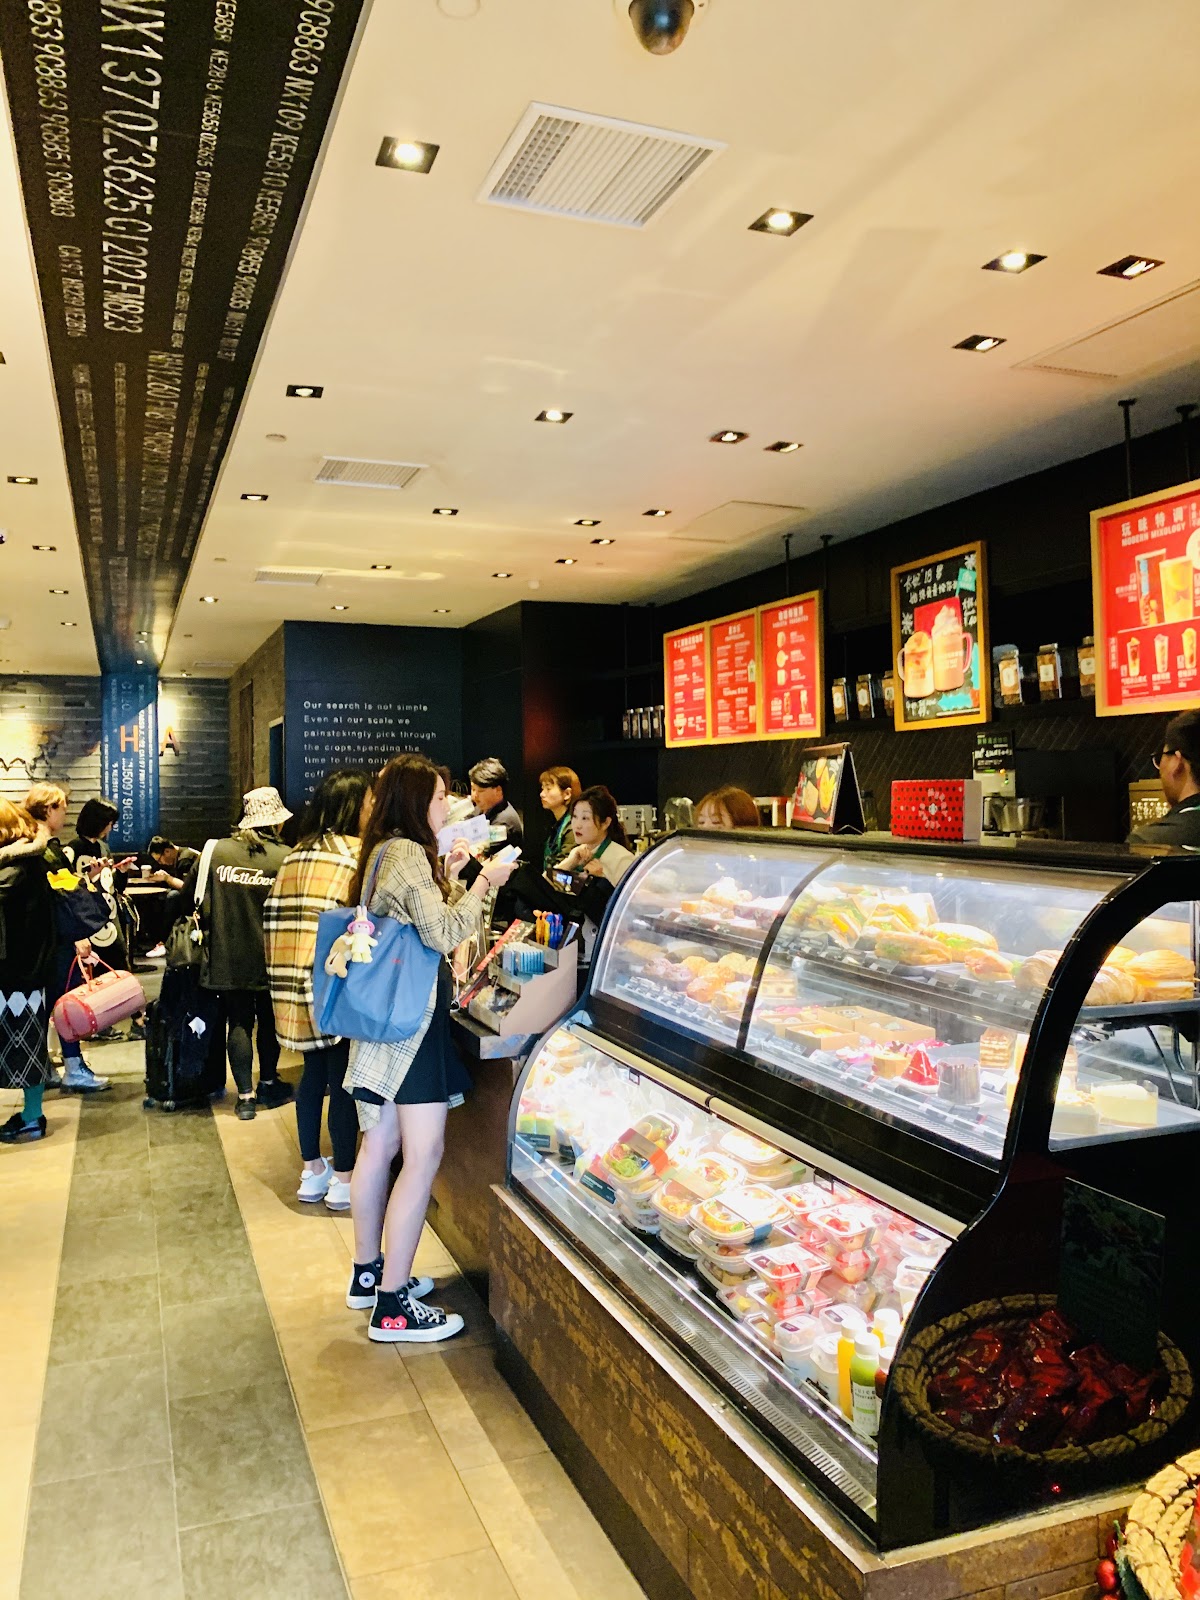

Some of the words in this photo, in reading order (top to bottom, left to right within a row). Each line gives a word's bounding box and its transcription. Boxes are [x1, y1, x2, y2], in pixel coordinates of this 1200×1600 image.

[28, 0, 64, 40] 853
[1121, 506, 1184, 537] 玩味特调
[1150, 522, 1186, 539] MIXOLOGY
[303, 701, 322, 710] Our
[326, 702, 360, 710] search
[364, 702, 373, 711] is
[377, 703, 393, 711] not
[396, 703, 428, 713] simple
[303, 715, 329, 723] Even
[333, 716, 343, 724] at
[367, 716, 394, 725] scale
[119, 725, 139, 753] H
[159, 726, 179, 756] A
[376, 730, 396, 739] pick
[400, 731, 437, 741] through
[304, 743, 320, 751] the
[404, 744, 420, 752] the
[304, 756, 326, 764] time
[330, 756, 341, 764] to
[344, 756, 364, 764] find
[367, 756, 389, 766] only
